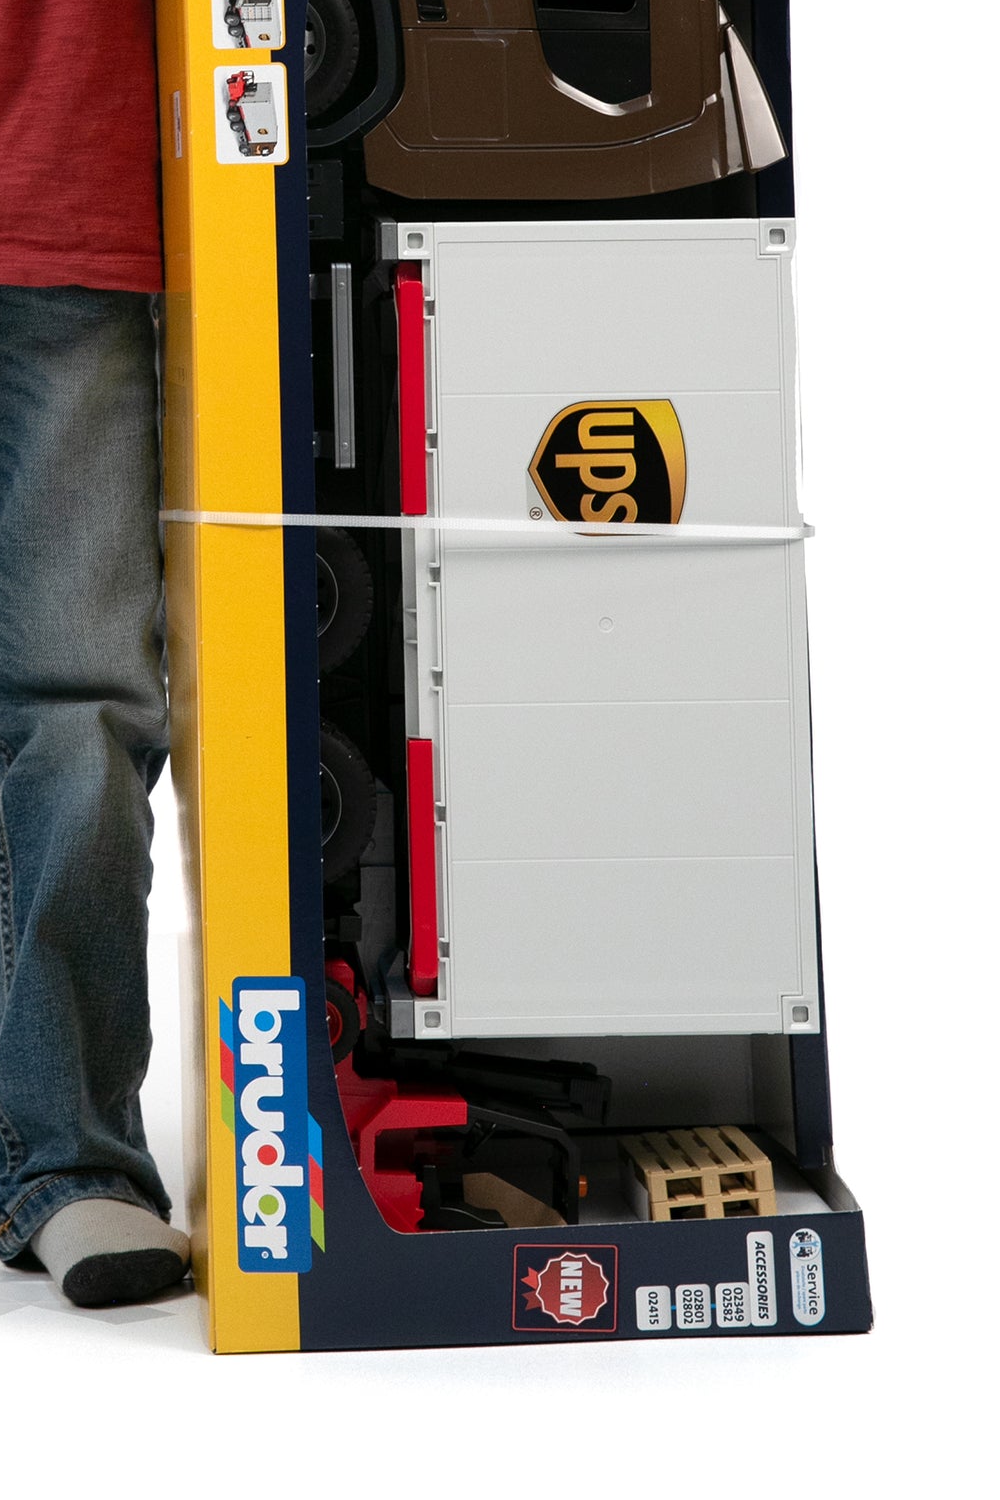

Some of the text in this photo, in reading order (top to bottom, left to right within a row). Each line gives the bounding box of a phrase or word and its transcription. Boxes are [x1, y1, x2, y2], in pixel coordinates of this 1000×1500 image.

[238, 989, 304, 1260] bruder
[560, 1261, 582, 1317] NEW
[754, 1241, 769, 1320] ACCESSORIES
[806, 1264, 820, 1315] Service
[648, 1291, 659, 1325] 02415
[682, 1289, 693, 1324] 02802
[693, 1289, 704, 1323] 02801
[722, 1288, 733, 1322] 02582
[733, 1287, 744, 1322] 02349
